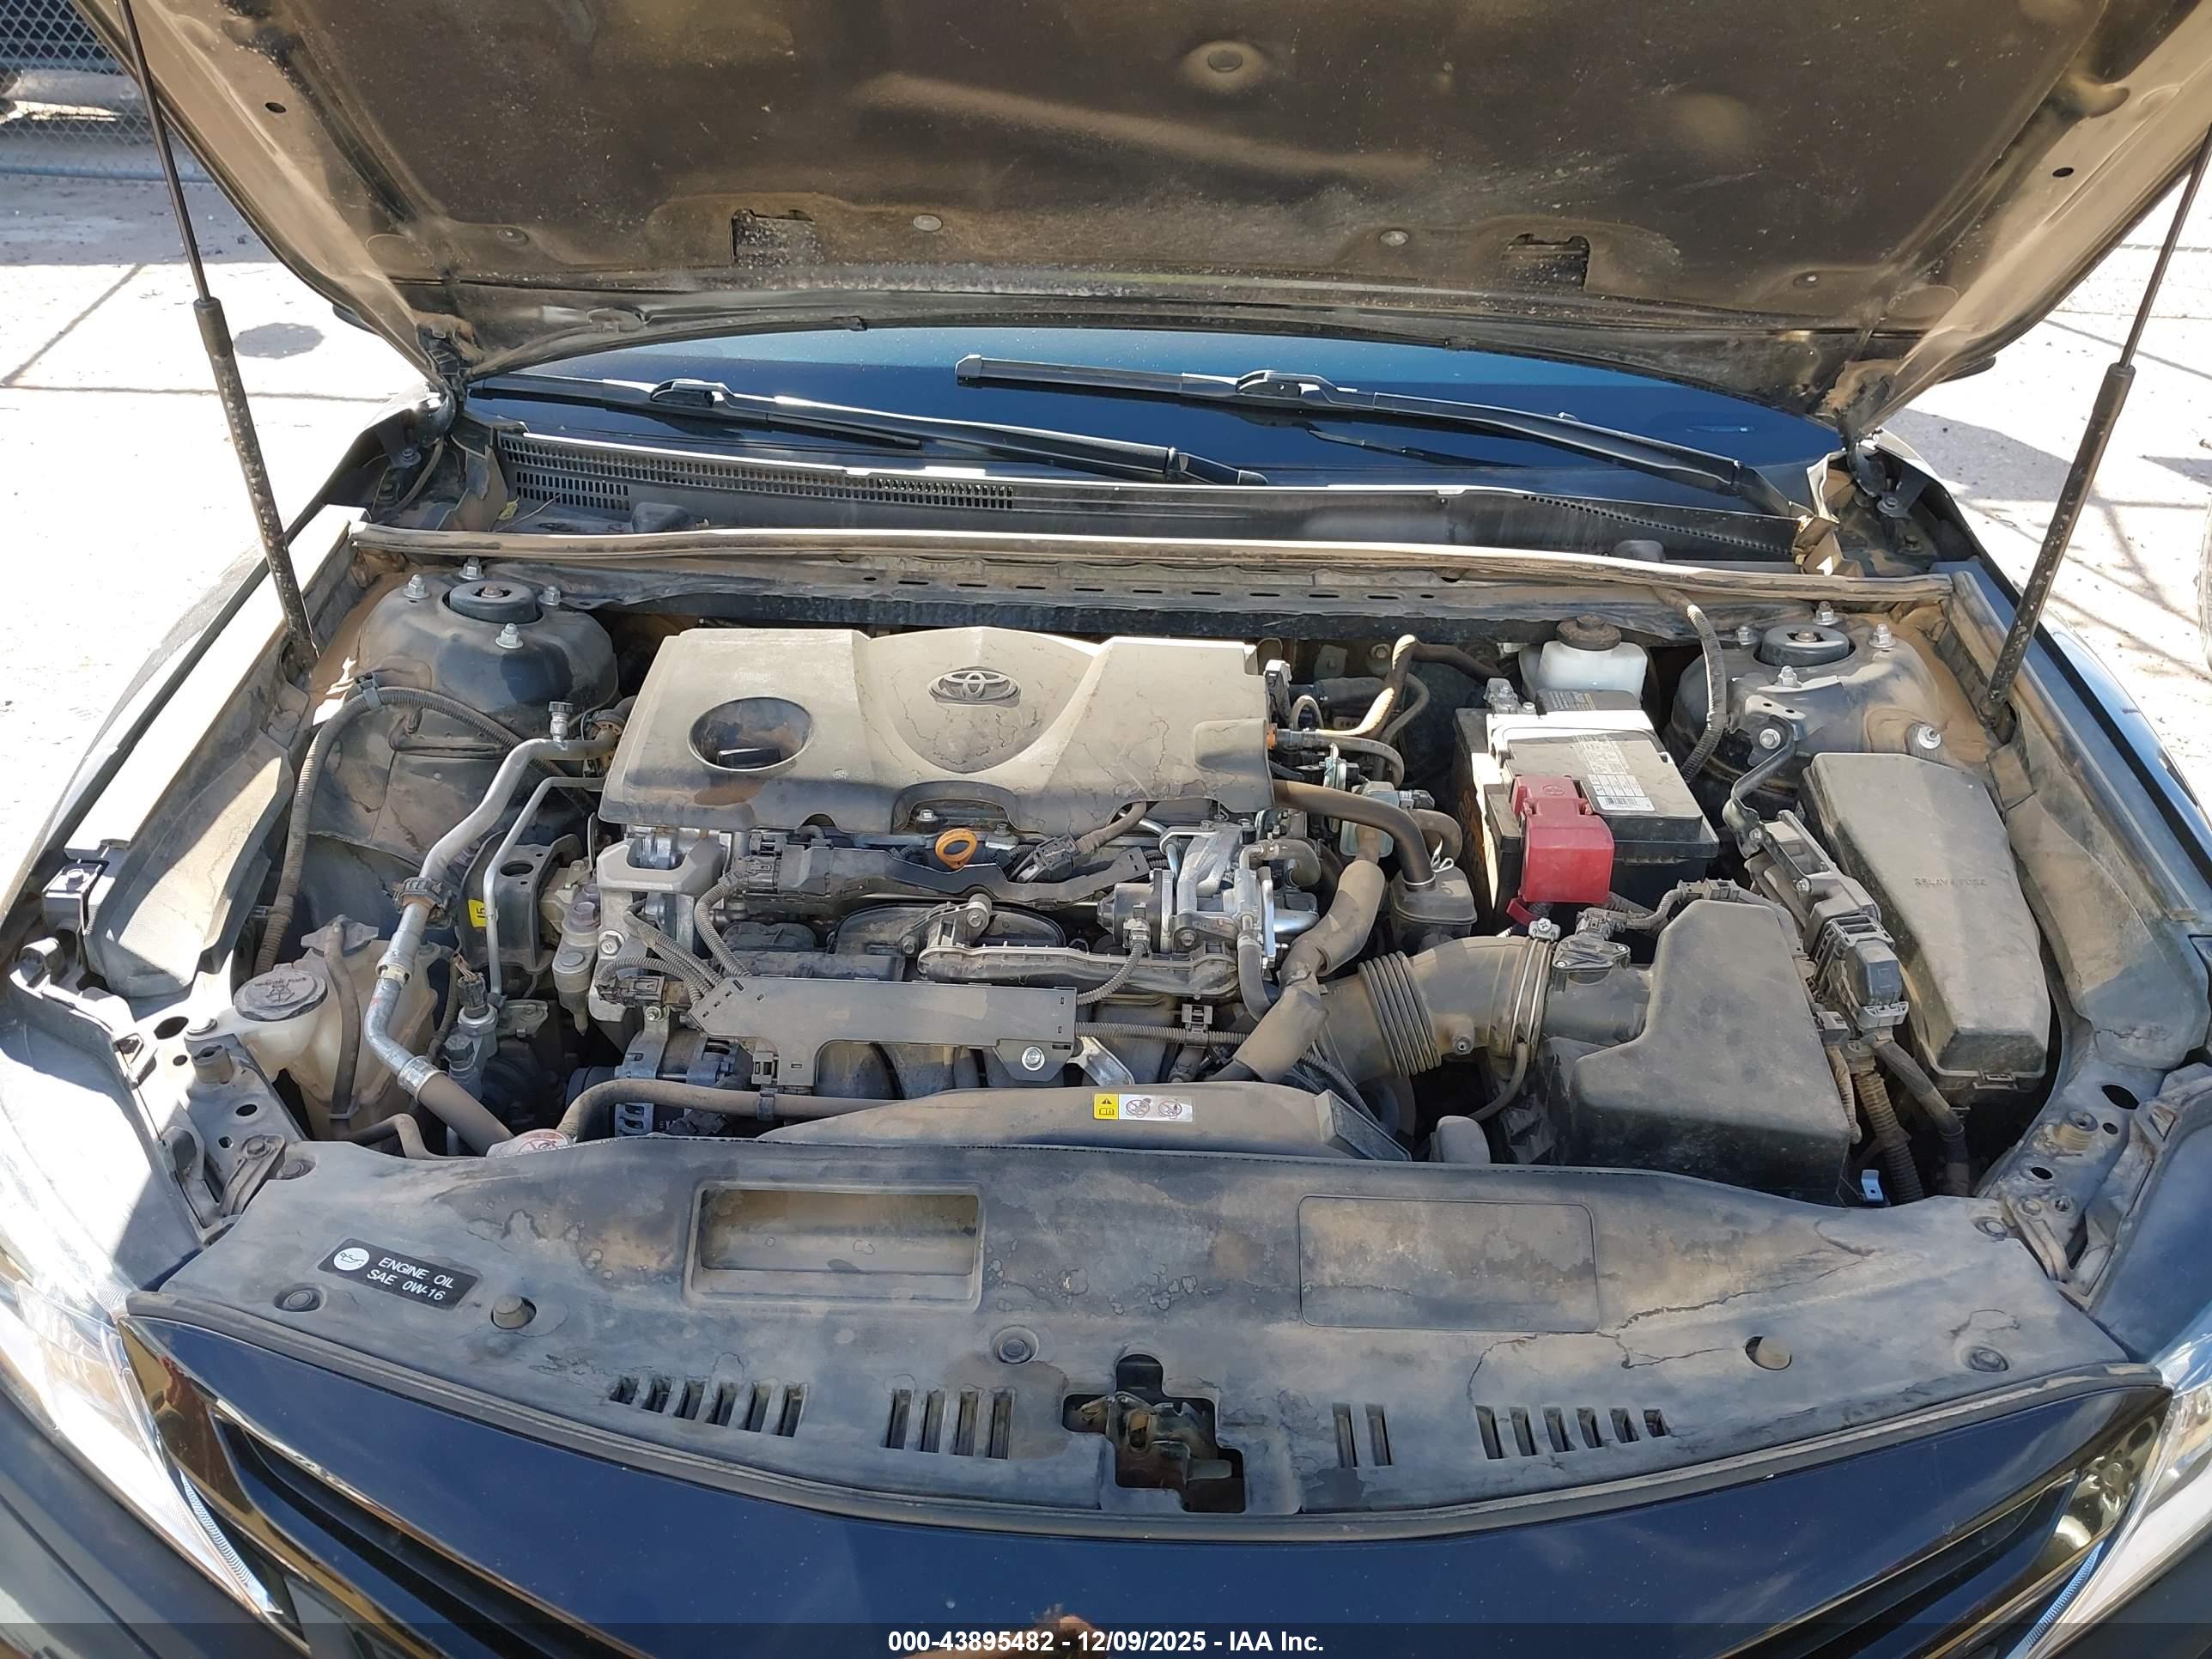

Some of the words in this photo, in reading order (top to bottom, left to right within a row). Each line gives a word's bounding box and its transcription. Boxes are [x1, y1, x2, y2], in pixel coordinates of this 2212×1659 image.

[367, 1269, 398, 1285] SAE
[402, 1280, 447, 1300] 0W-16
[378, 1257, 429, 1279] ENGINE
[434, 1274, 453, 1289] OIL
